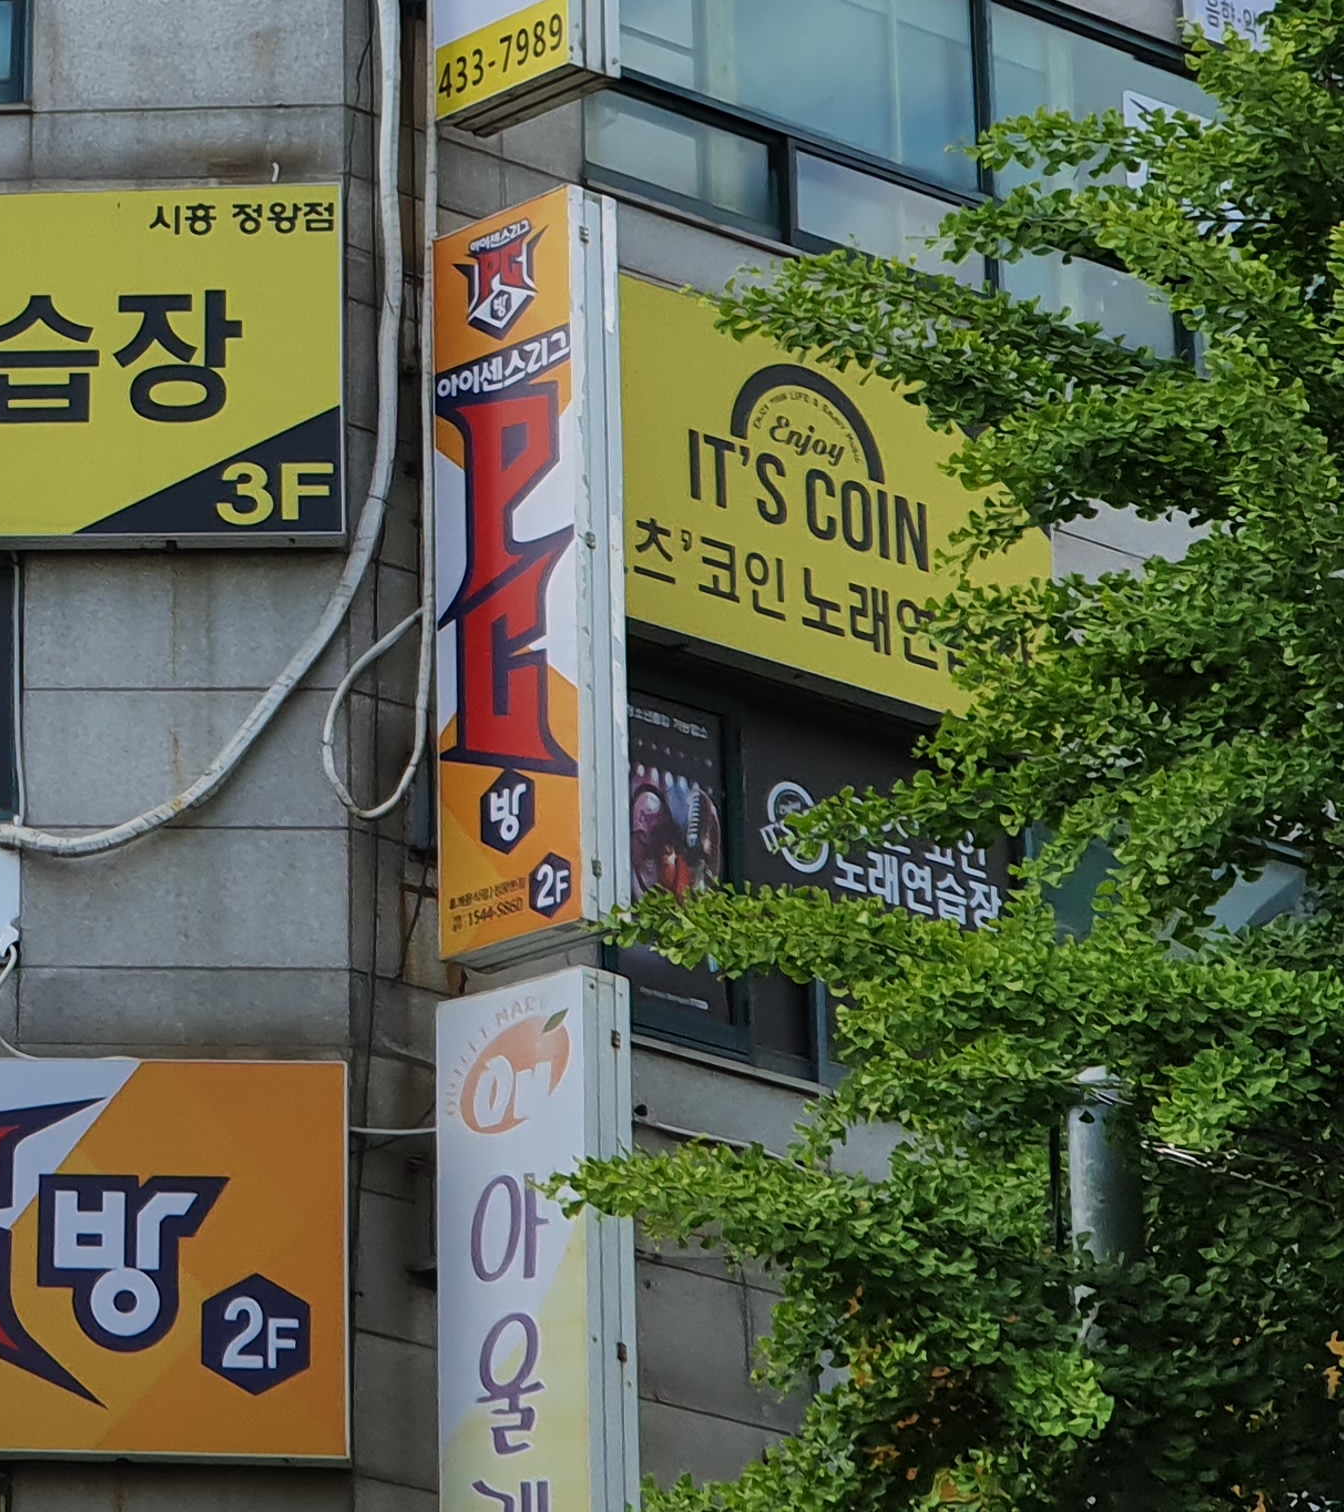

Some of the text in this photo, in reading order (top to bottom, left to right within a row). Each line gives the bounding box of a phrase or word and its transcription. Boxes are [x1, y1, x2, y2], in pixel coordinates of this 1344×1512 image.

[438, 13, 564, 100] 433-7989
[232, 201, 336, 235] 정왕점
[436, 331, 570, 400] 아이센스리그
[769, 414, 847, 467] Enjoy
[216, 461, 335, 526] 3F
[688, 428, 930, 573] IT'S COIN
[536, 863, 570, 909] 2F
[221, 1296, 301, 1370] 2F
[470, 1172, 550, 1512] 아울
